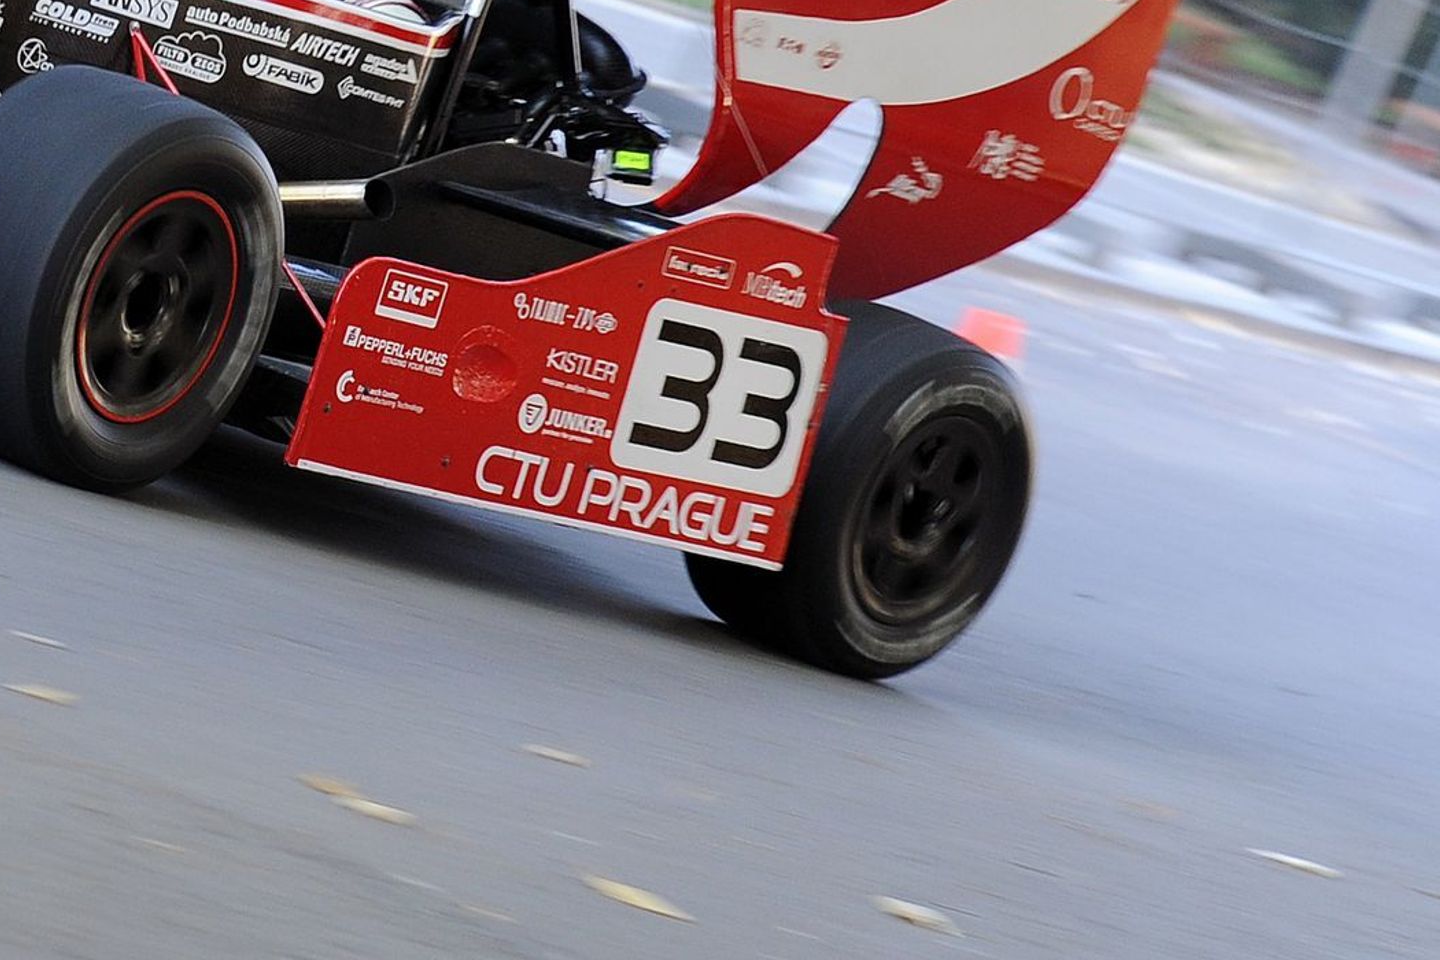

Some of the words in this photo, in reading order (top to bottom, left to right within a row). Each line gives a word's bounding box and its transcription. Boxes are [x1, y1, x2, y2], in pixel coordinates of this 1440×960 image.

[186, 4, 219, 25] auto
[219, 11, 292, 42] Podbabská
[289, 32, 361, 67] AIRTECH
[386, 280, 441, 308] SKF
[357, 334, 449, 368] PEPPERL+FUCHS
[546, 347, 620, 384] KISTLER
[628, 318, 803, 471] 33
[544, 408, 608, 437] JUNKER
[474, 444, 576, 508] CTU
[576, 467, 775, 554] PRAGUE
